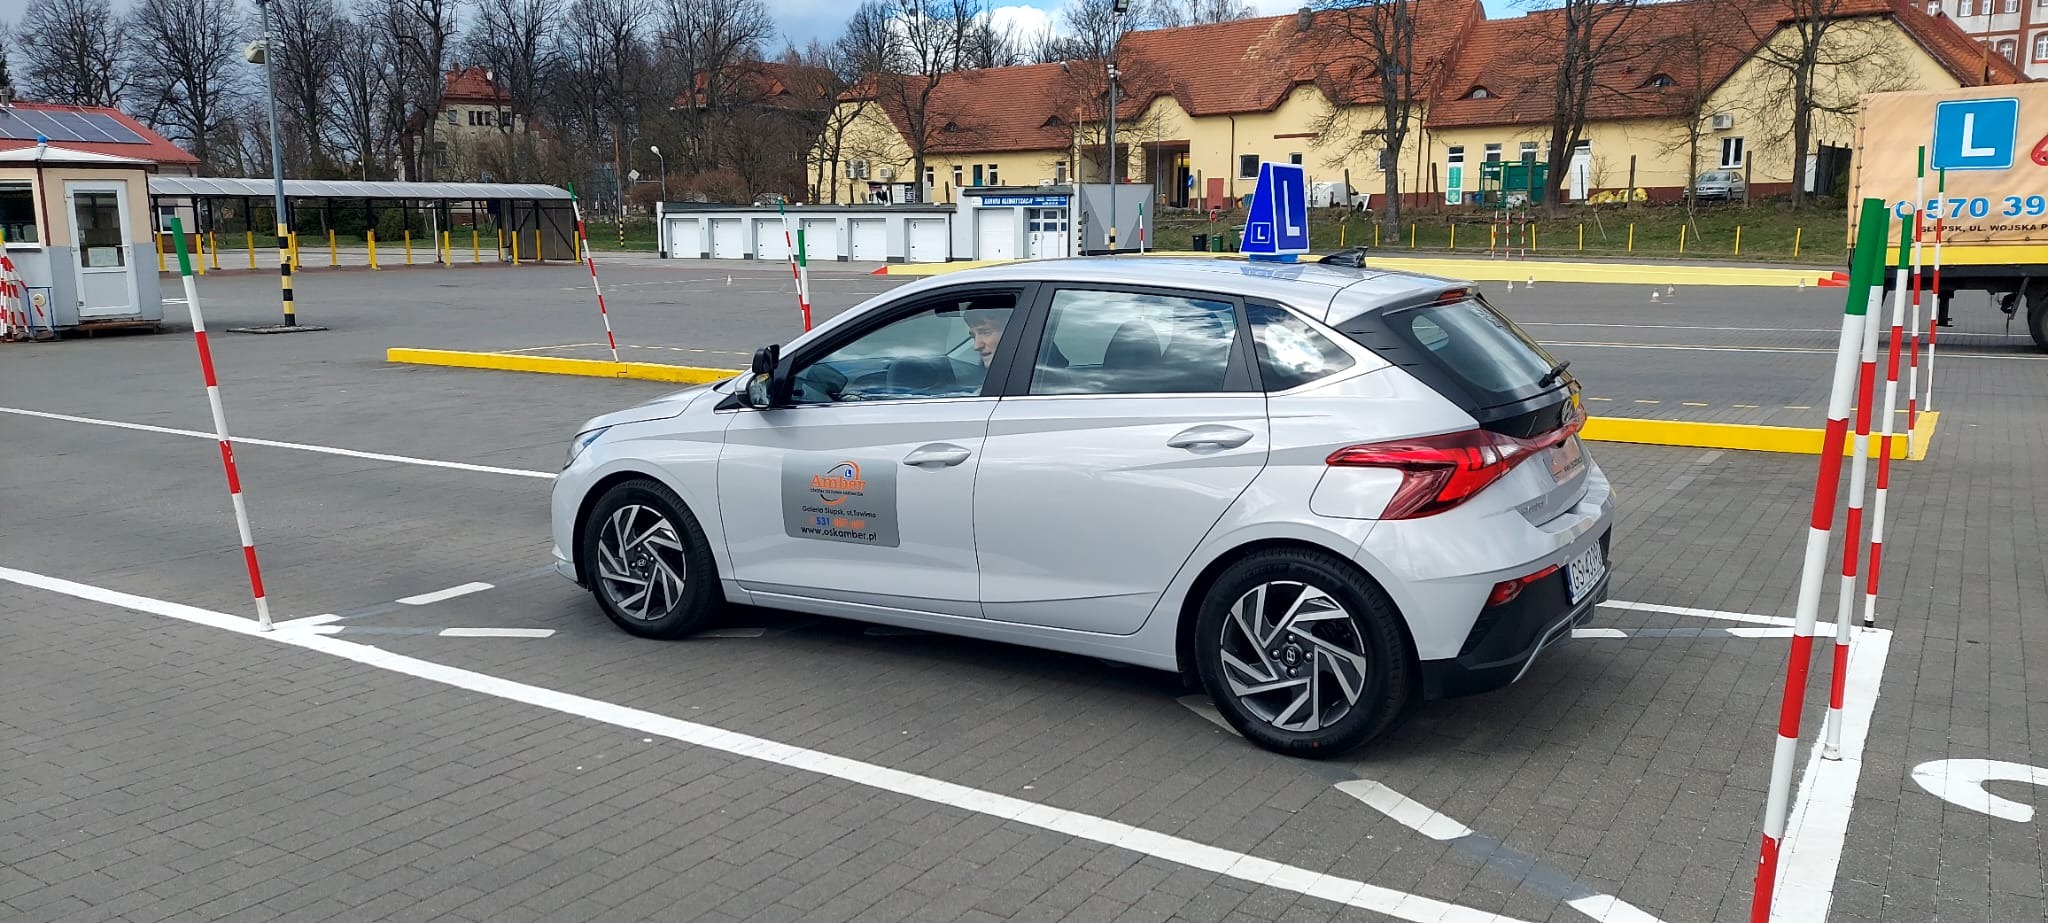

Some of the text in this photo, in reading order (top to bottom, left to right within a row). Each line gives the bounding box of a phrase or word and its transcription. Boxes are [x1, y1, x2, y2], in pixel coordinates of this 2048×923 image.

[1961, 113, 1996, 157] L
[1283, 180, 1300, 237] L
[1926, 197, 1990, 219] 570
[1257, 226, 1266, 240] L
[811, 475, 865, 489] Amber
[816, 516, 830, 526] 531
[801, 526, 877, 541] www.oskamber.pl
